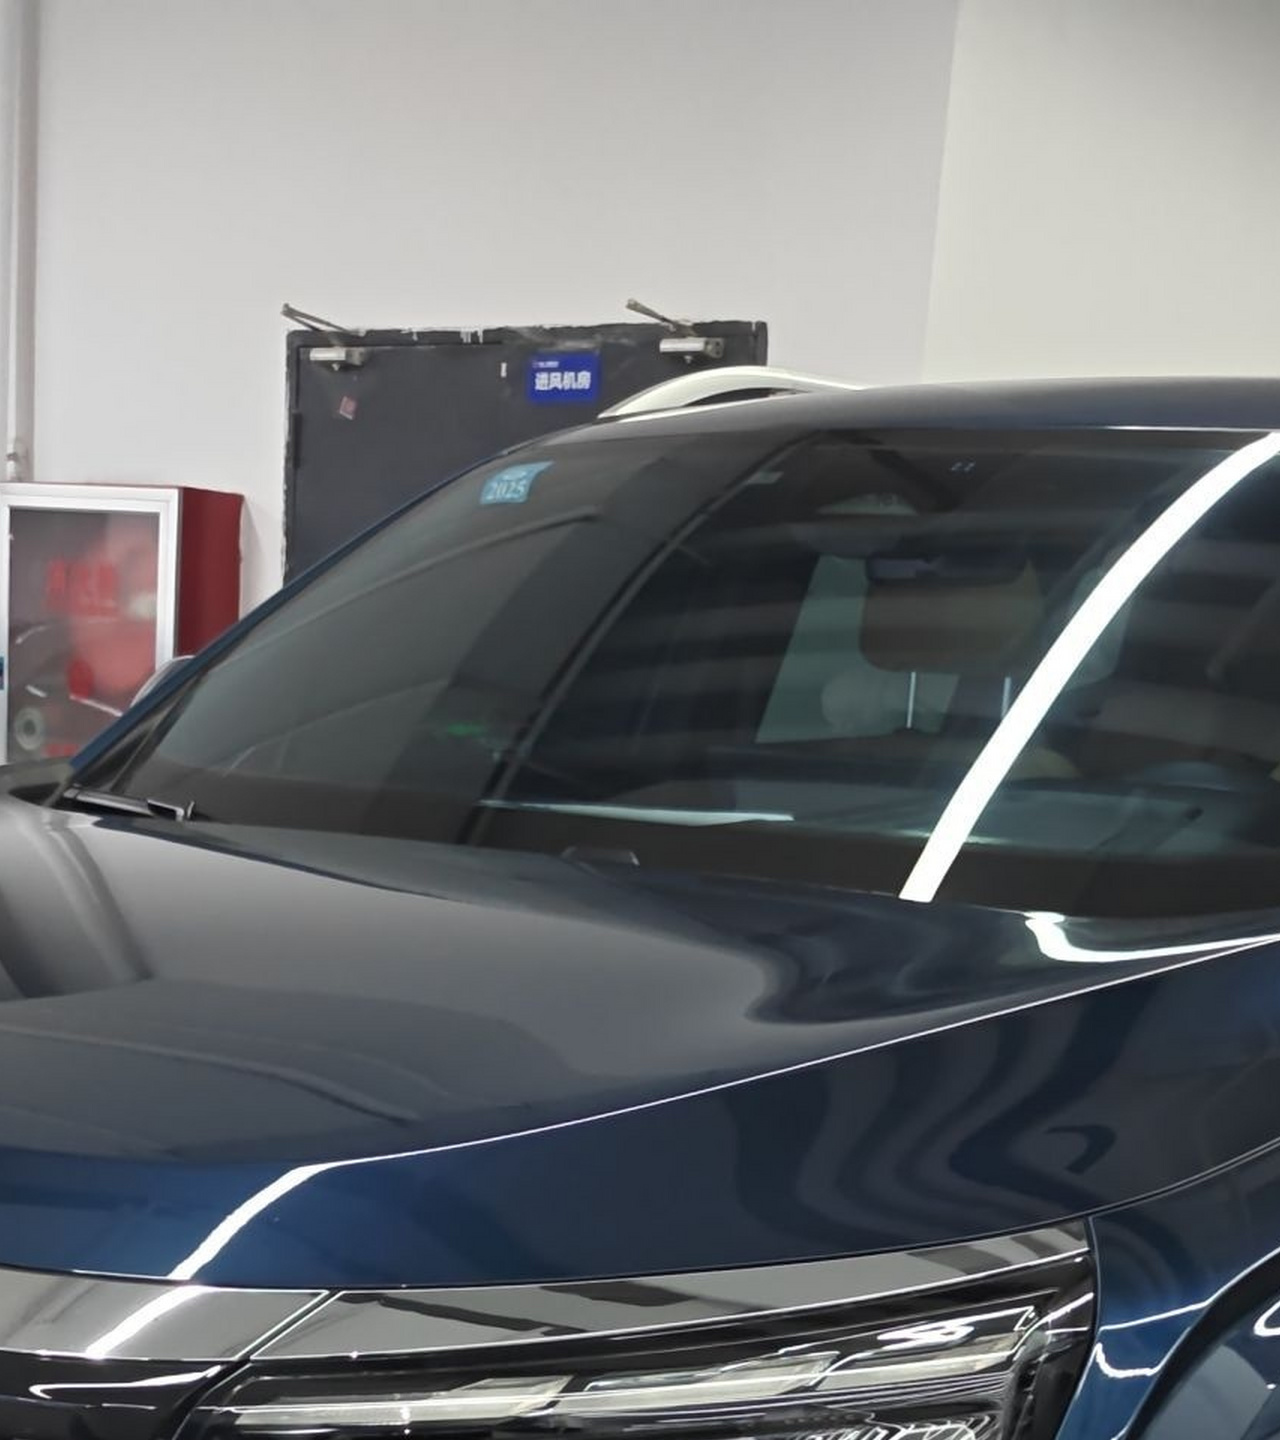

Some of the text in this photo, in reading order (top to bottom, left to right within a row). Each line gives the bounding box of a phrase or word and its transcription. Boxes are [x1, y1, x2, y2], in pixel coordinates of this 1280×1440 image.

[535, 370, 591, 391] 进风机房
[485, 482, 526, 499] 2025
